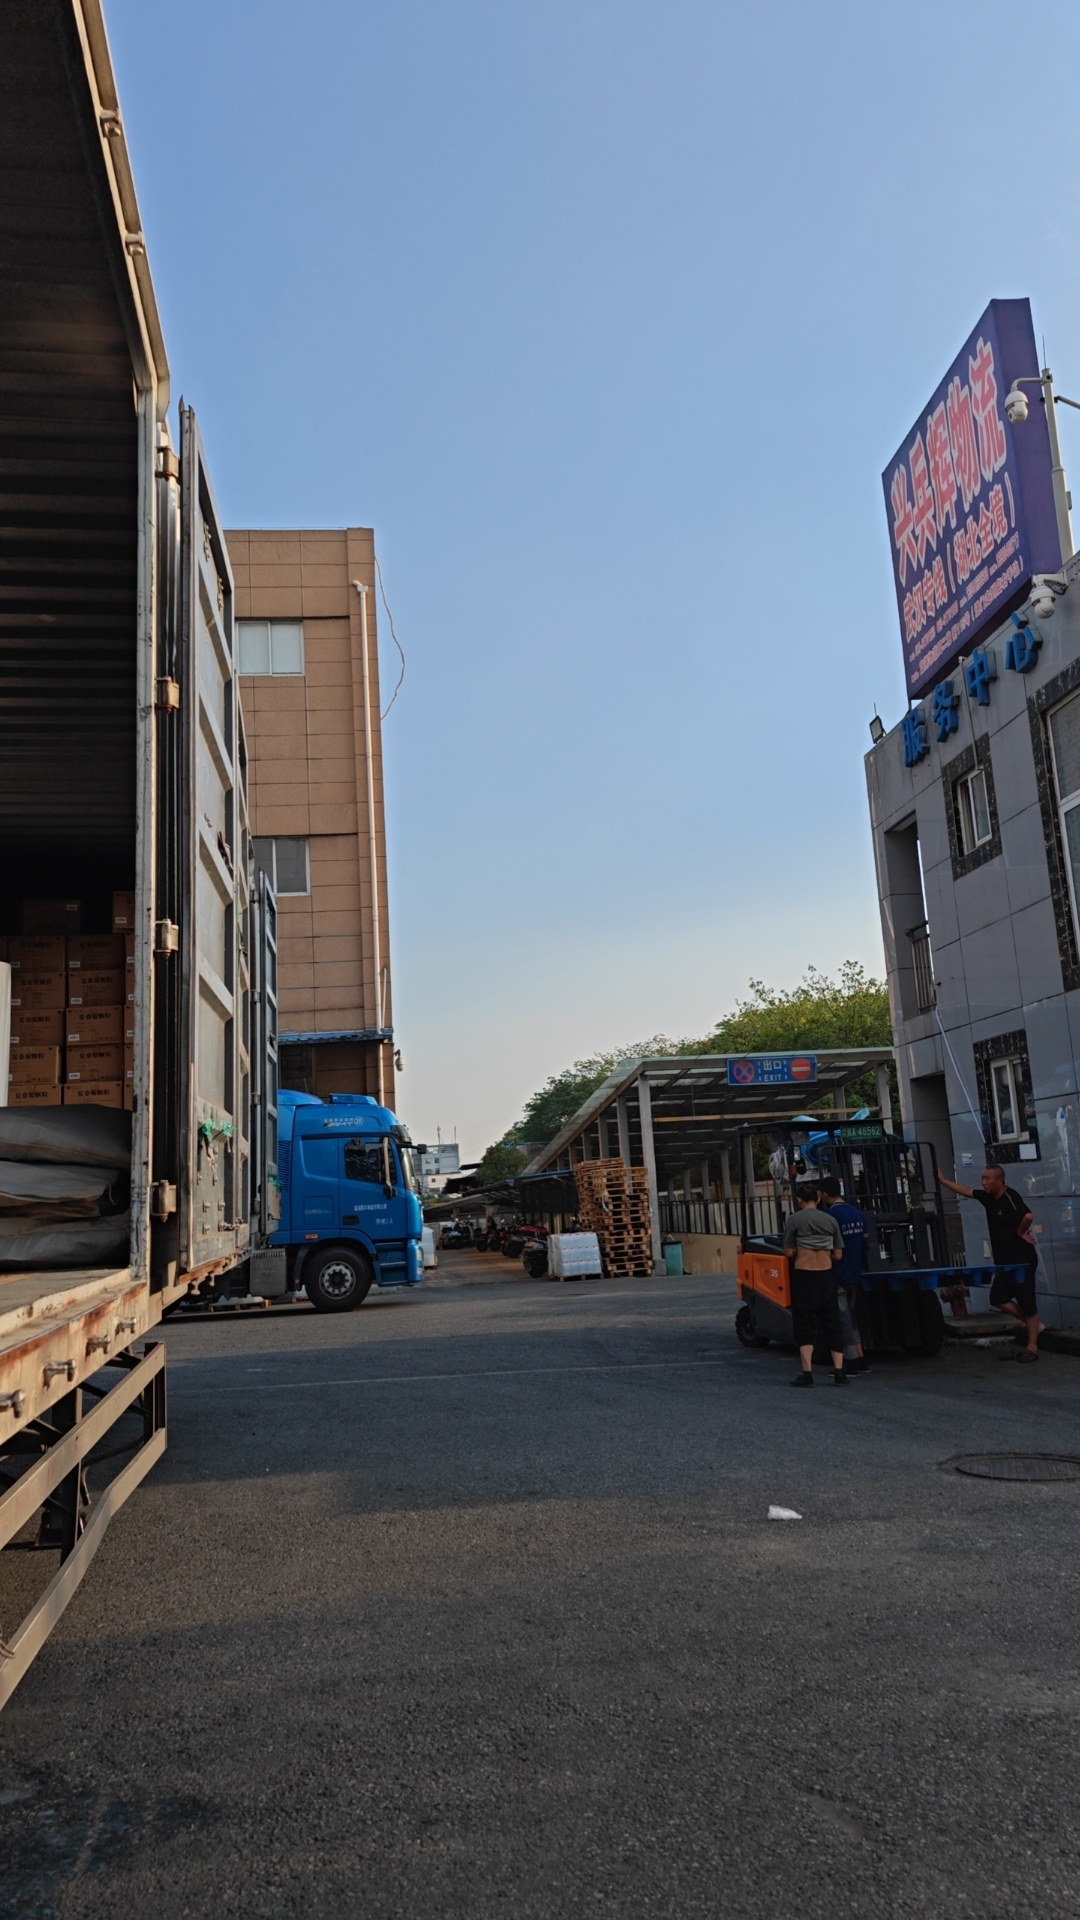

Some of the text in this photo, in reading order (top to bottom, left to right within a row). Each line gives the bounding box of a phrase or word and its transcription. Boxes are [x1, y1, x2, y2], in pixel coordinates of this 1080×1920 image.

[890, 336, 1007, 588] 兴兵辉物流
[901, 611, 1043, 767] 服务中心
[763, 1060, 782, 1071] 出口
[764, 1073, 782, 1082] EXIT
[858, 1125, 880, 1136] 46562
